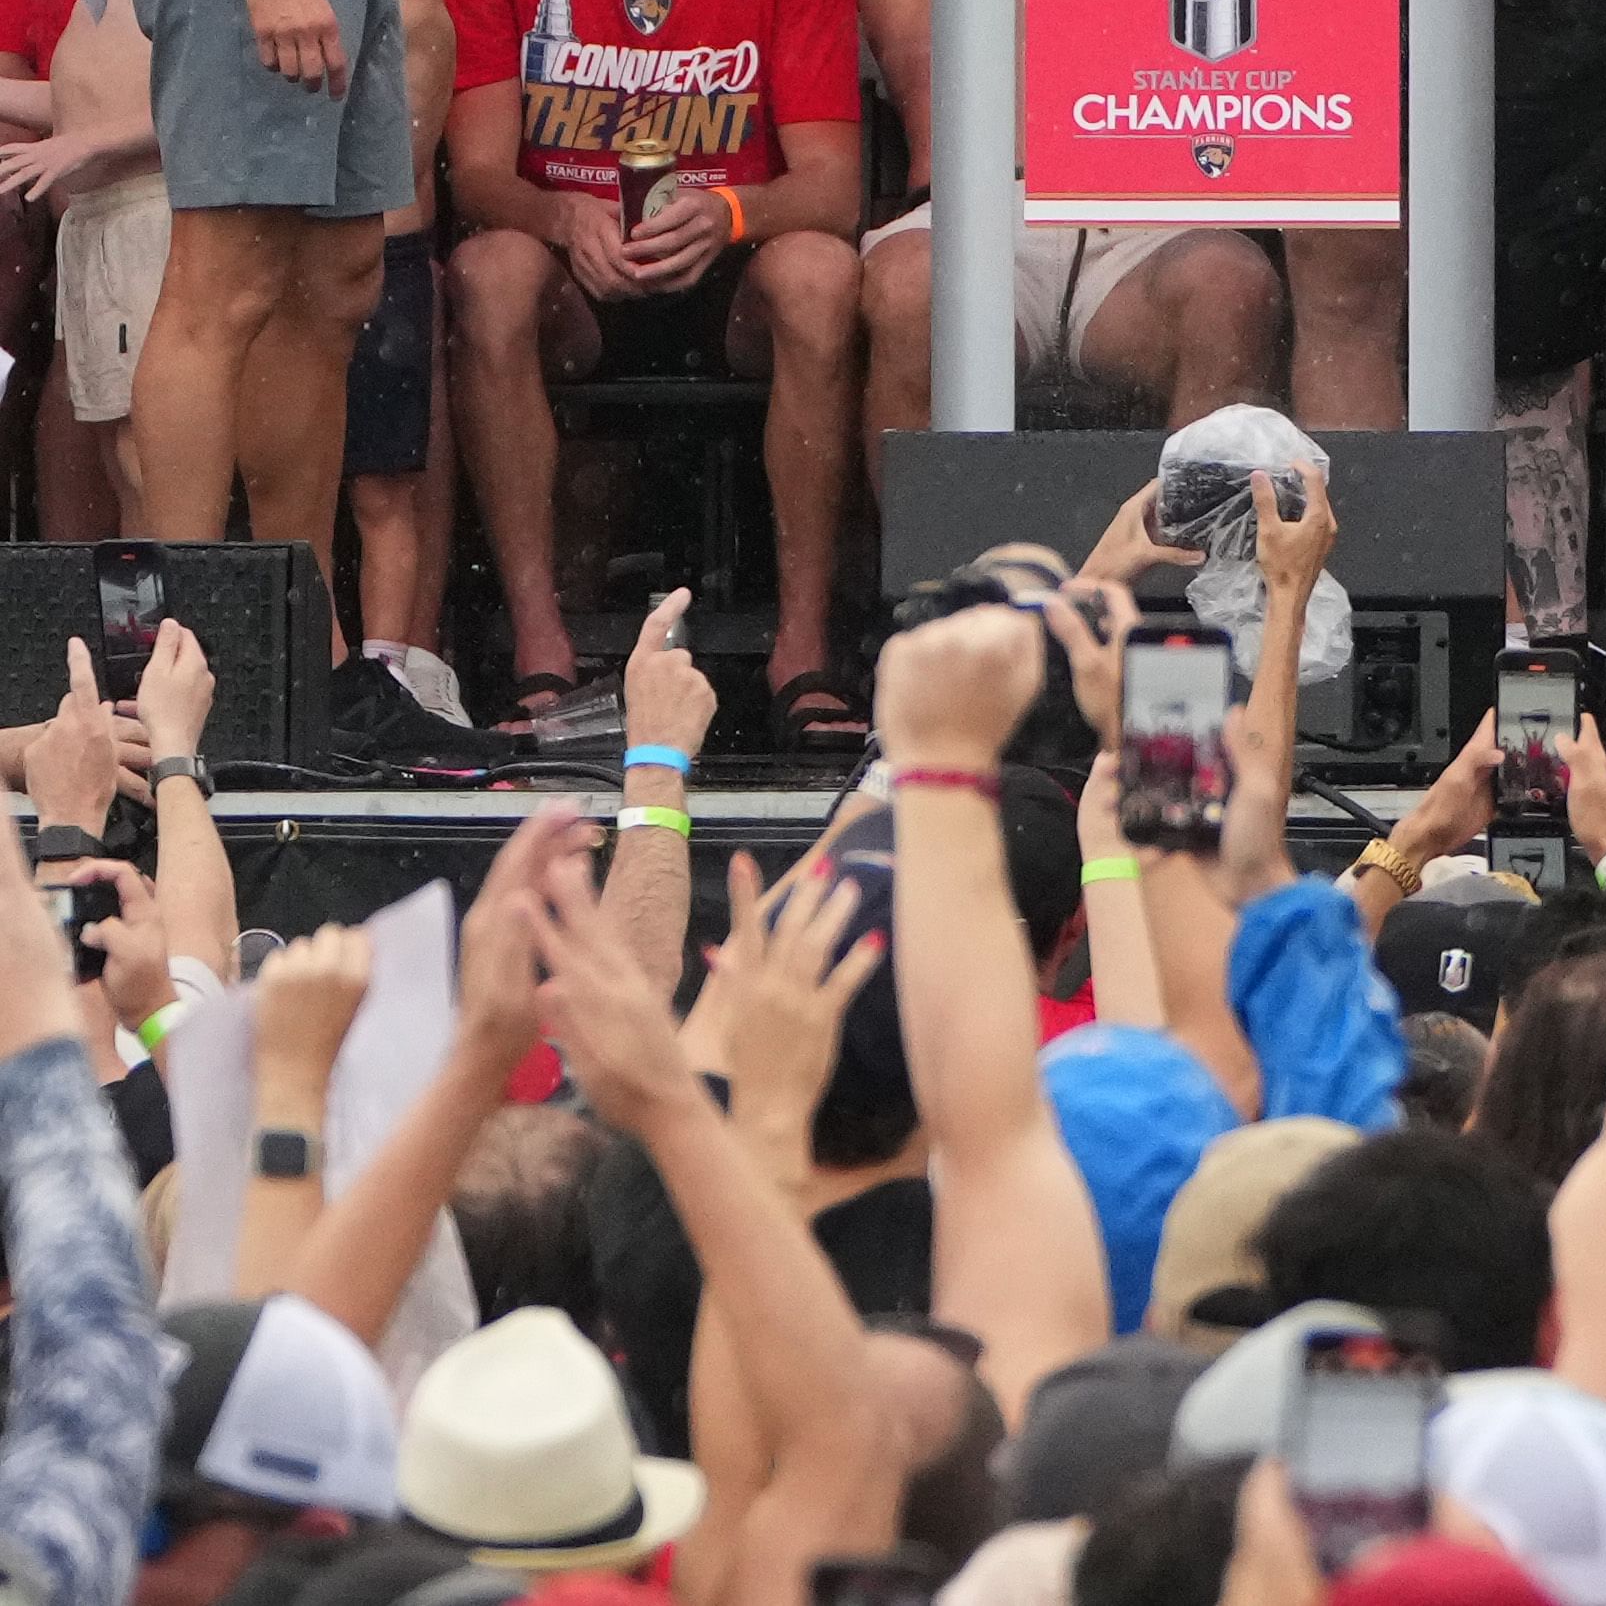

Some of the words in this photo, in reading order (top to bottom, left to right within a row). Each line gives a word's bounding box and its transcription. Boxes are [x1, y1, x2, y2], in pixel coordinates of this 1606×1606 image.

[551, 40, 759, 96] CONQUERED
[1133, 69, 1240, 91] STANLEY
[1246, 69, 1292, 91] CUP
[525, 83, 617, 151] THE
[610, 92, 759, 156] HUNT
[1073, 93, 1353, 132] CHAMPIONS
[545, 163, 595, 181] STANLEY
[596, 168, 618, 182] CUP
